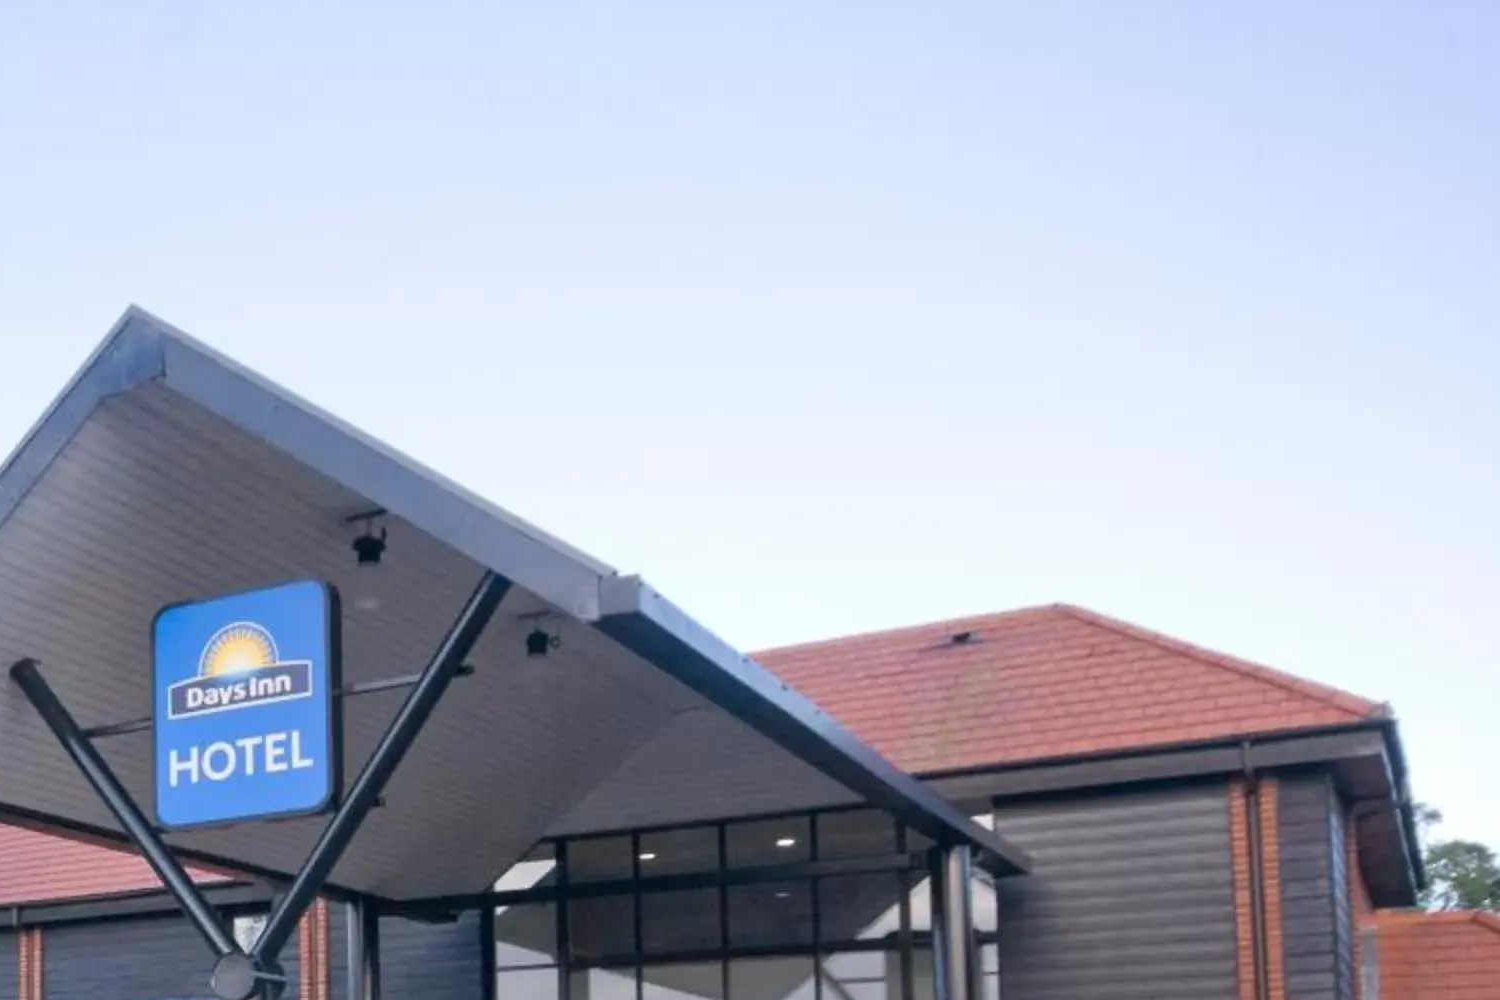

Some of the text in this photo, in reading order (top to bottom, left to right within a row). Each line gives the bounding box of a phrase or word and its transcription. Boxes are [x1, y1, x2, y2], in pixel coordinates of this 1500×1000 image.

[186, 675, 292, 708] Days Inn
[169, 730, 314, 788] HOTEL
